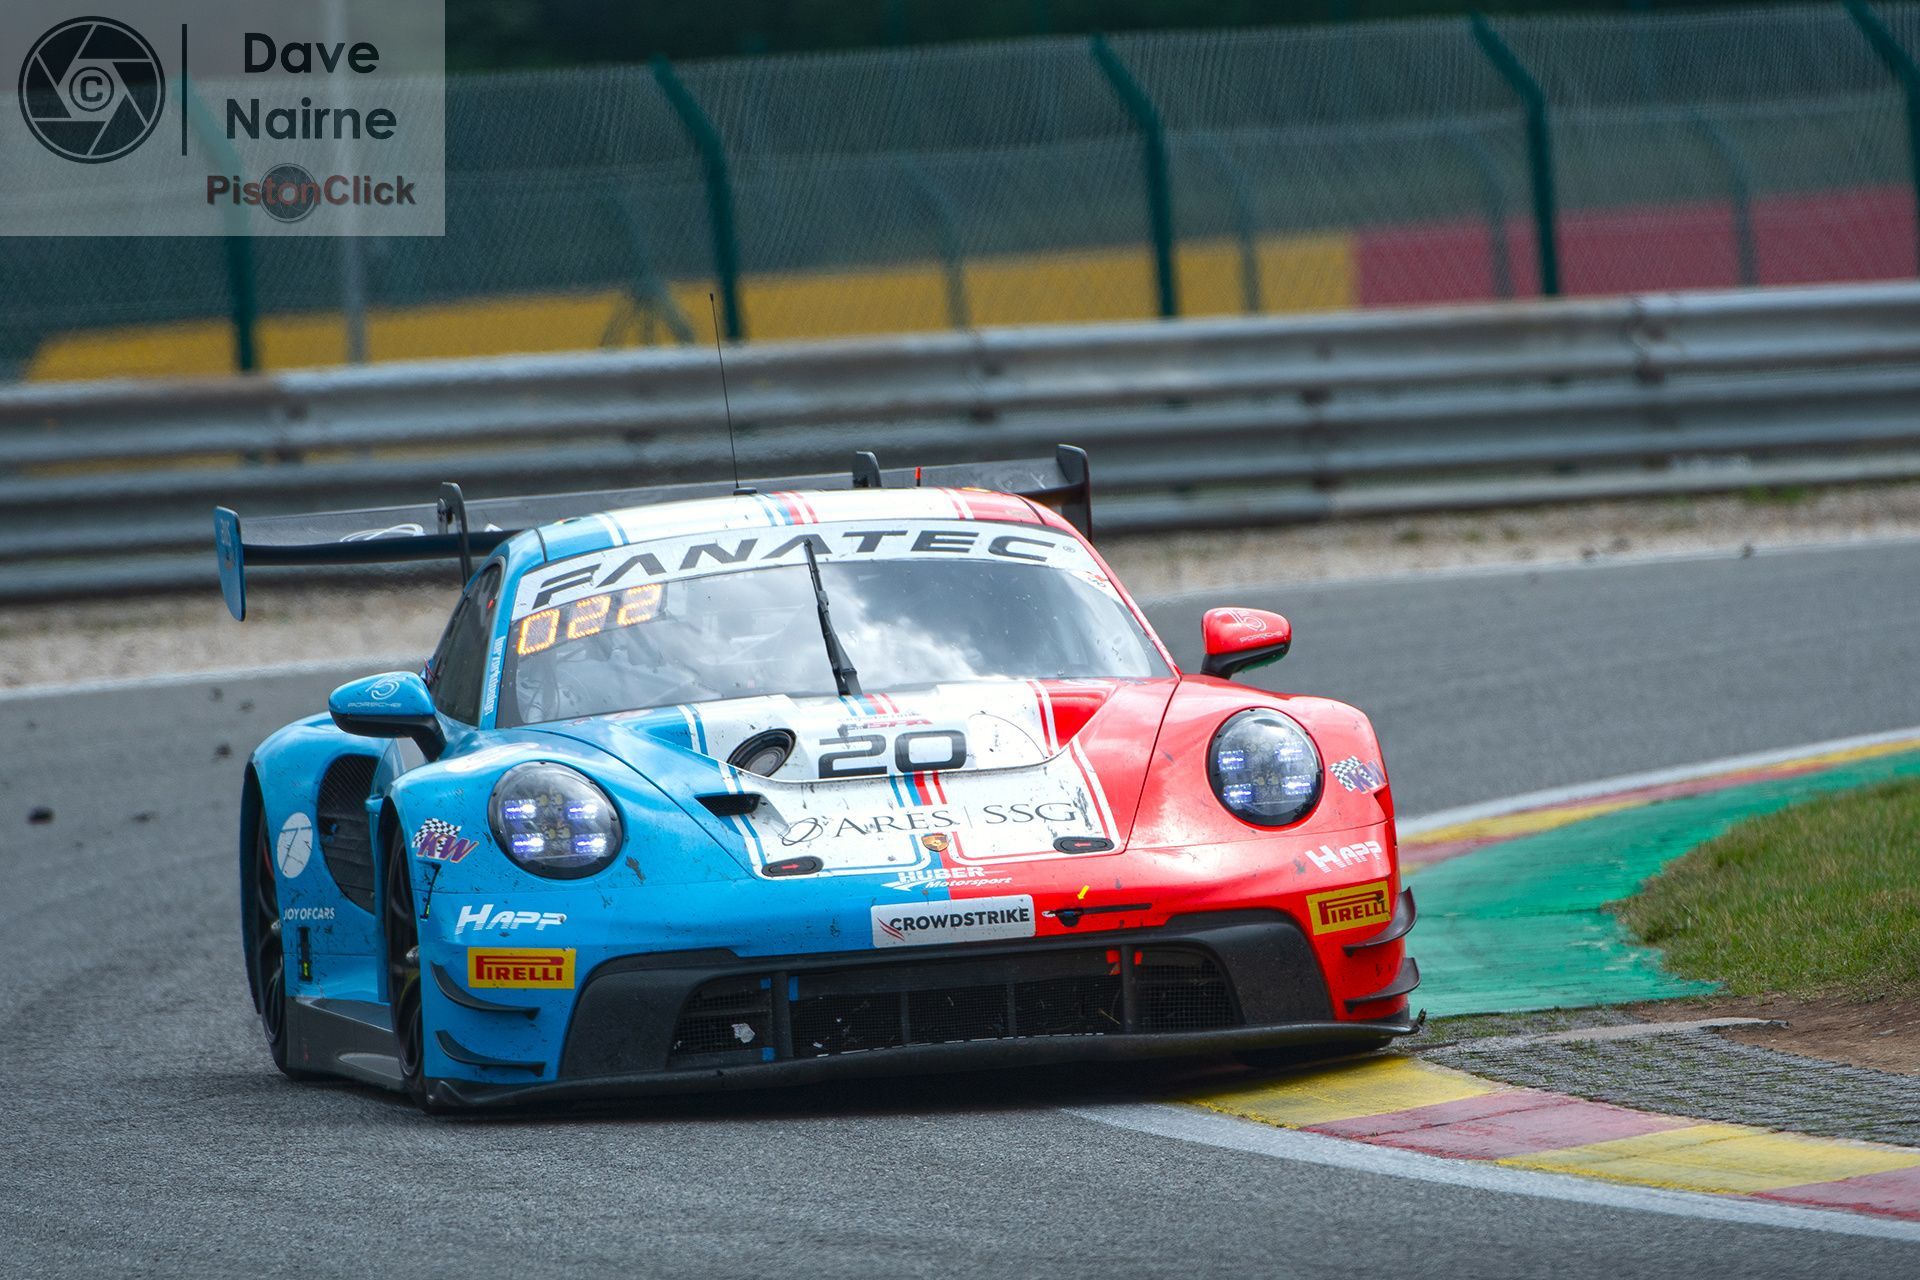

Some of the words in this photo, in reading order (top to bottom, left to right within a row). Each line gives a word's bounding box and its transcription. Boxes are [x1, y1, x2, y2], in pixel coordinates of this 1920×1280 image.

[517, 583, 662, 655] 022
[818, 730, 968, 779] 20
[834, 810, 954, 838] ARES
[983, 802, 1077, 825] SSG
[416, 830, 480, 863] KW
[899, 866, 986, 883] HUBER
[924, 876, 1013, 889] Motorsport
[889, 908, 1031, 932] CROWDSTRIKE
[1318, 890, 1388, 926] PIRELLI
[475, 955, 565, 981] PIRELLI
